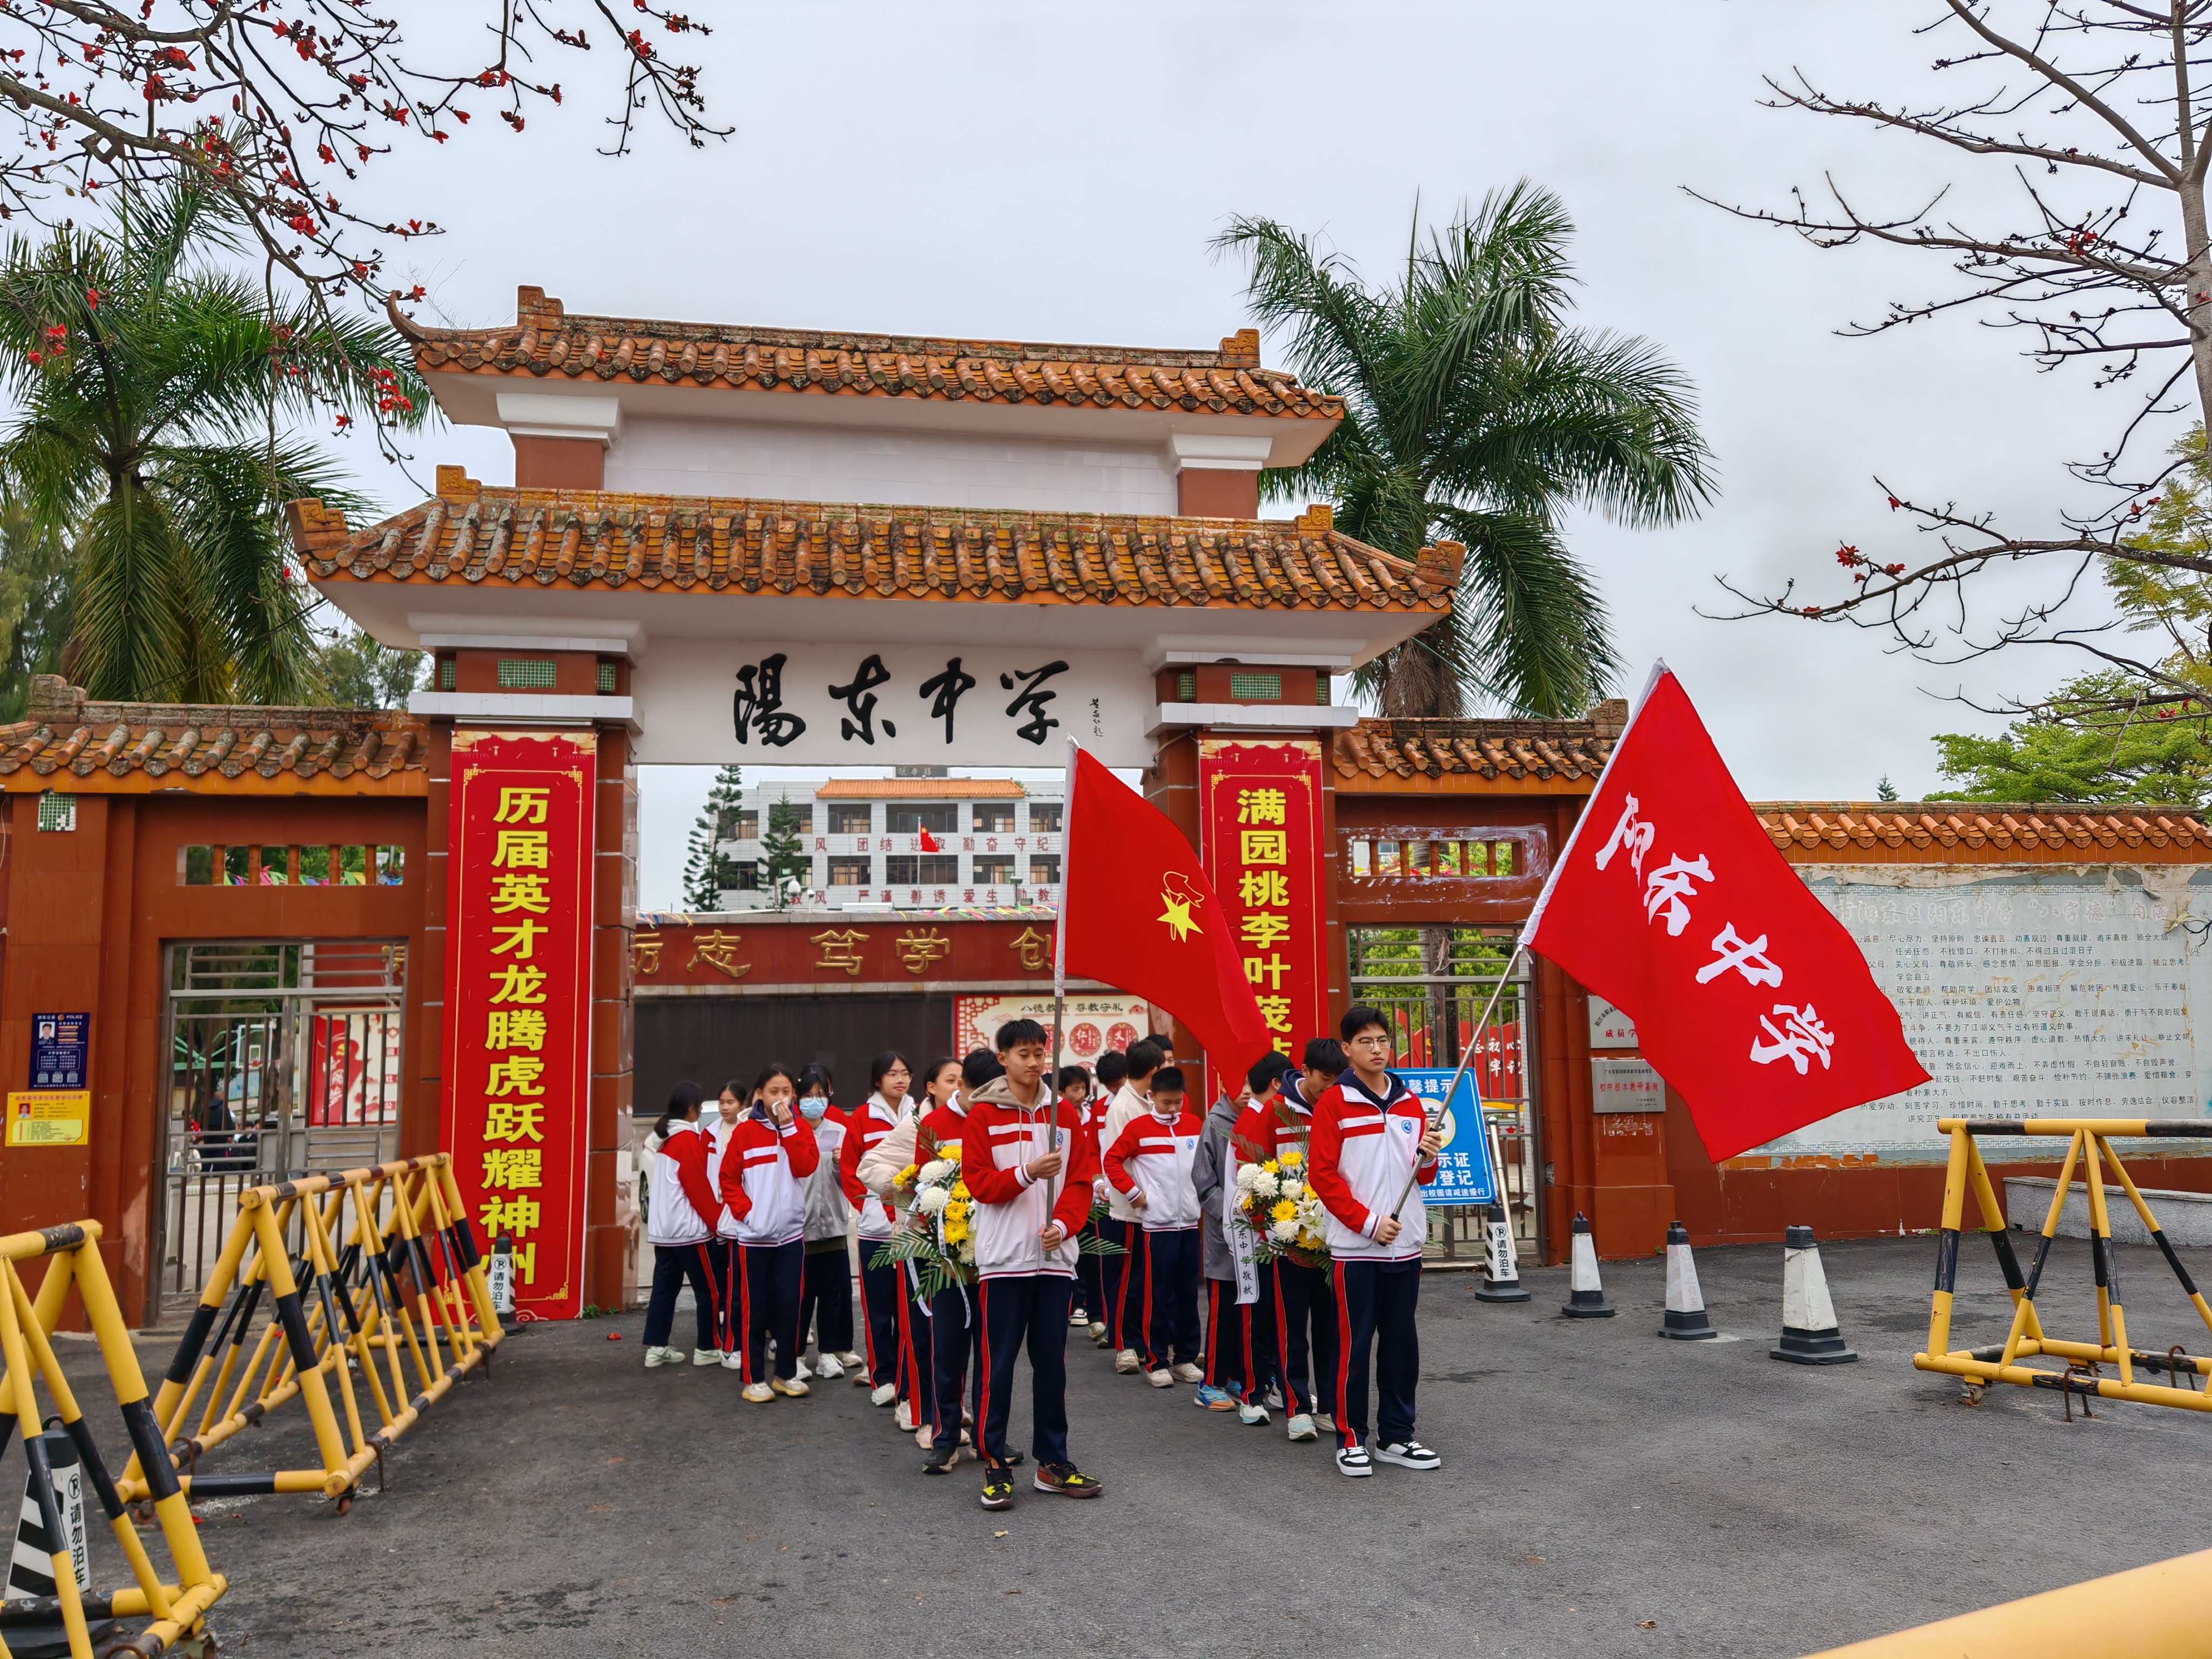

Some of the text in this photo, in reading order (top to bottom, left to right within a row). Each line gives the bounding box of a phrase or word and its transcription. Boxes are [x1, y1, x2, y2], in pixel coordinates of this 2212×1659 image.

[1402, 1079, 1453, 1094] 馨提示
[1496, 1239, 1510, 1277] 请勿泊车
[492, 1272, 505, 1311] 请勿泊车
[70, 1502, 86, 1587] 请勿泊车
